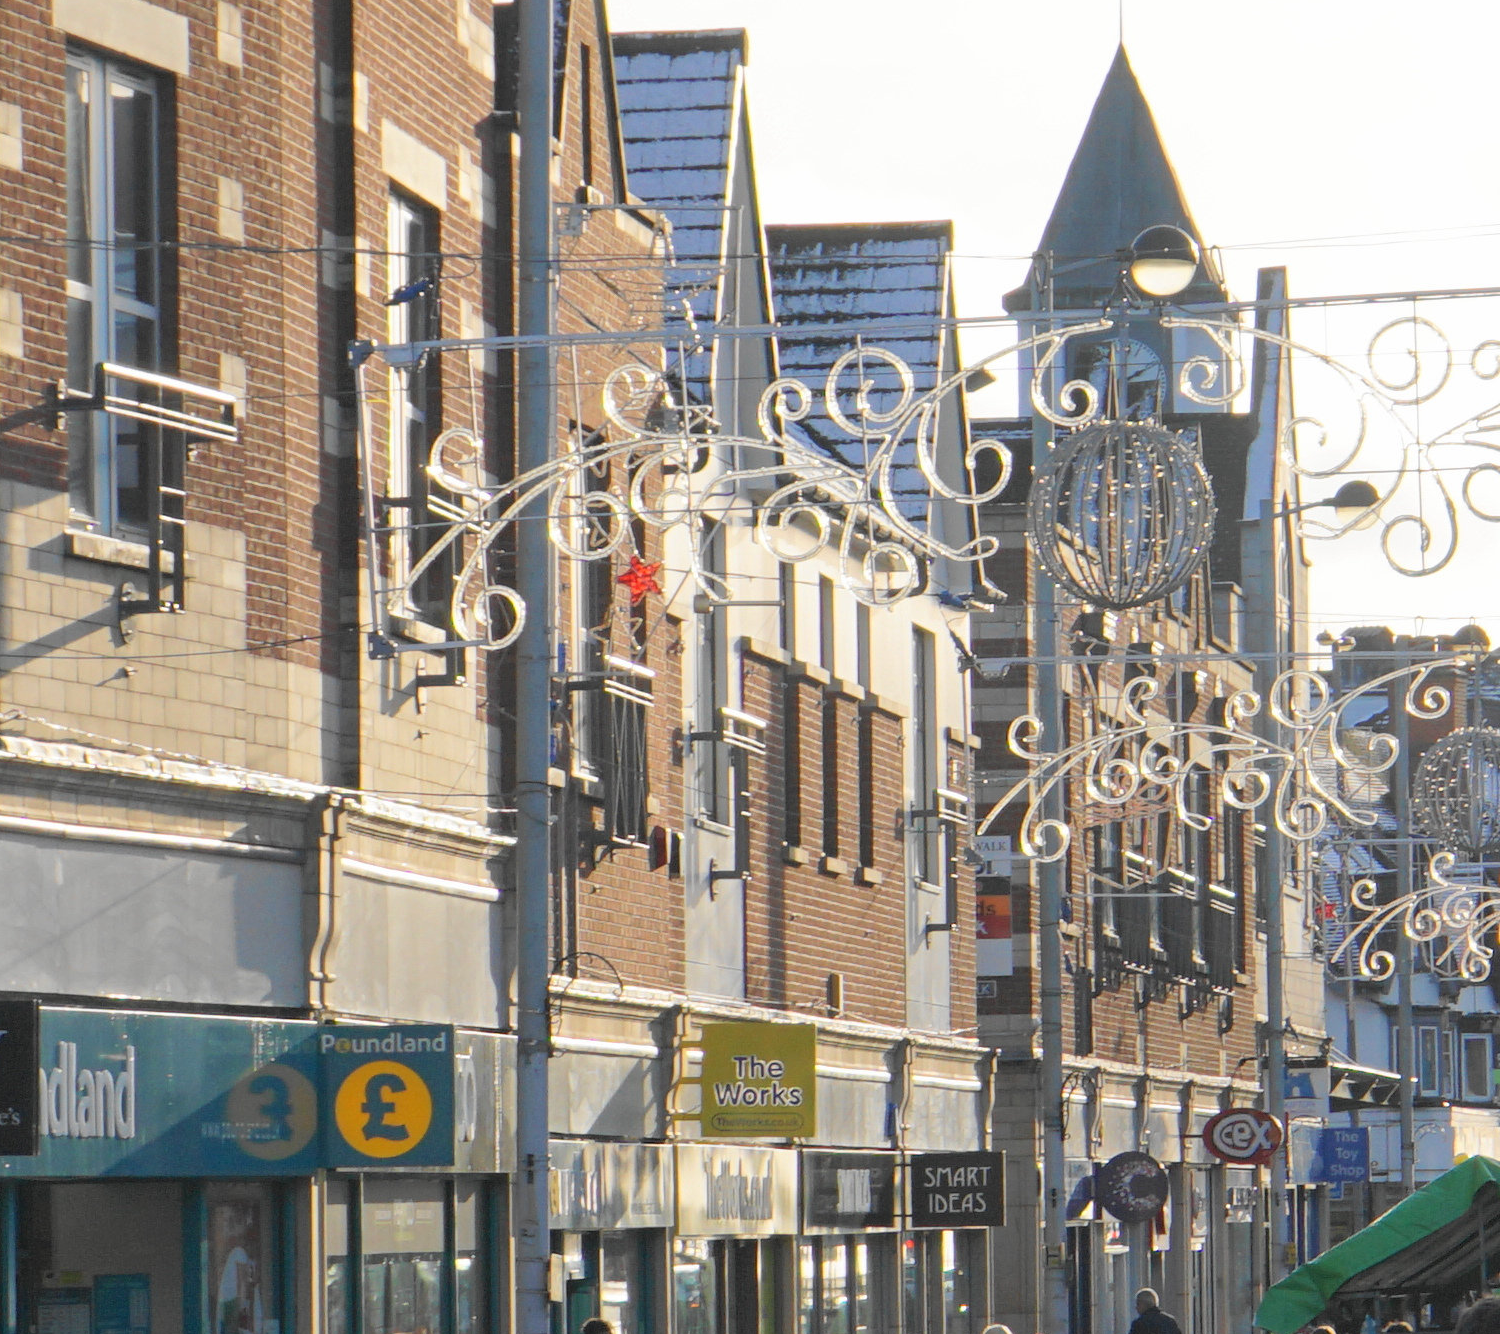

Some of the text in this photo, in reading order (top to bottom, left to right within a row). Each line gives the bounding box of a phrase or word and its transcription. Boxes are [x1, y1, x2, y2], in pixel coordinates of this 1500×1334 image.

[733, 1054, 785, 1079] The
[714, 1080, 804, 1107] Works
[1334, 1130, 1359, 1142] The
[1336, 1147, 1358, 1161] Toy
[924, 1166, 992, 1188] SMART
[1330, 1164, 1365, 1178] Shop
[929, 1192, 987, 1213] IDEAS
